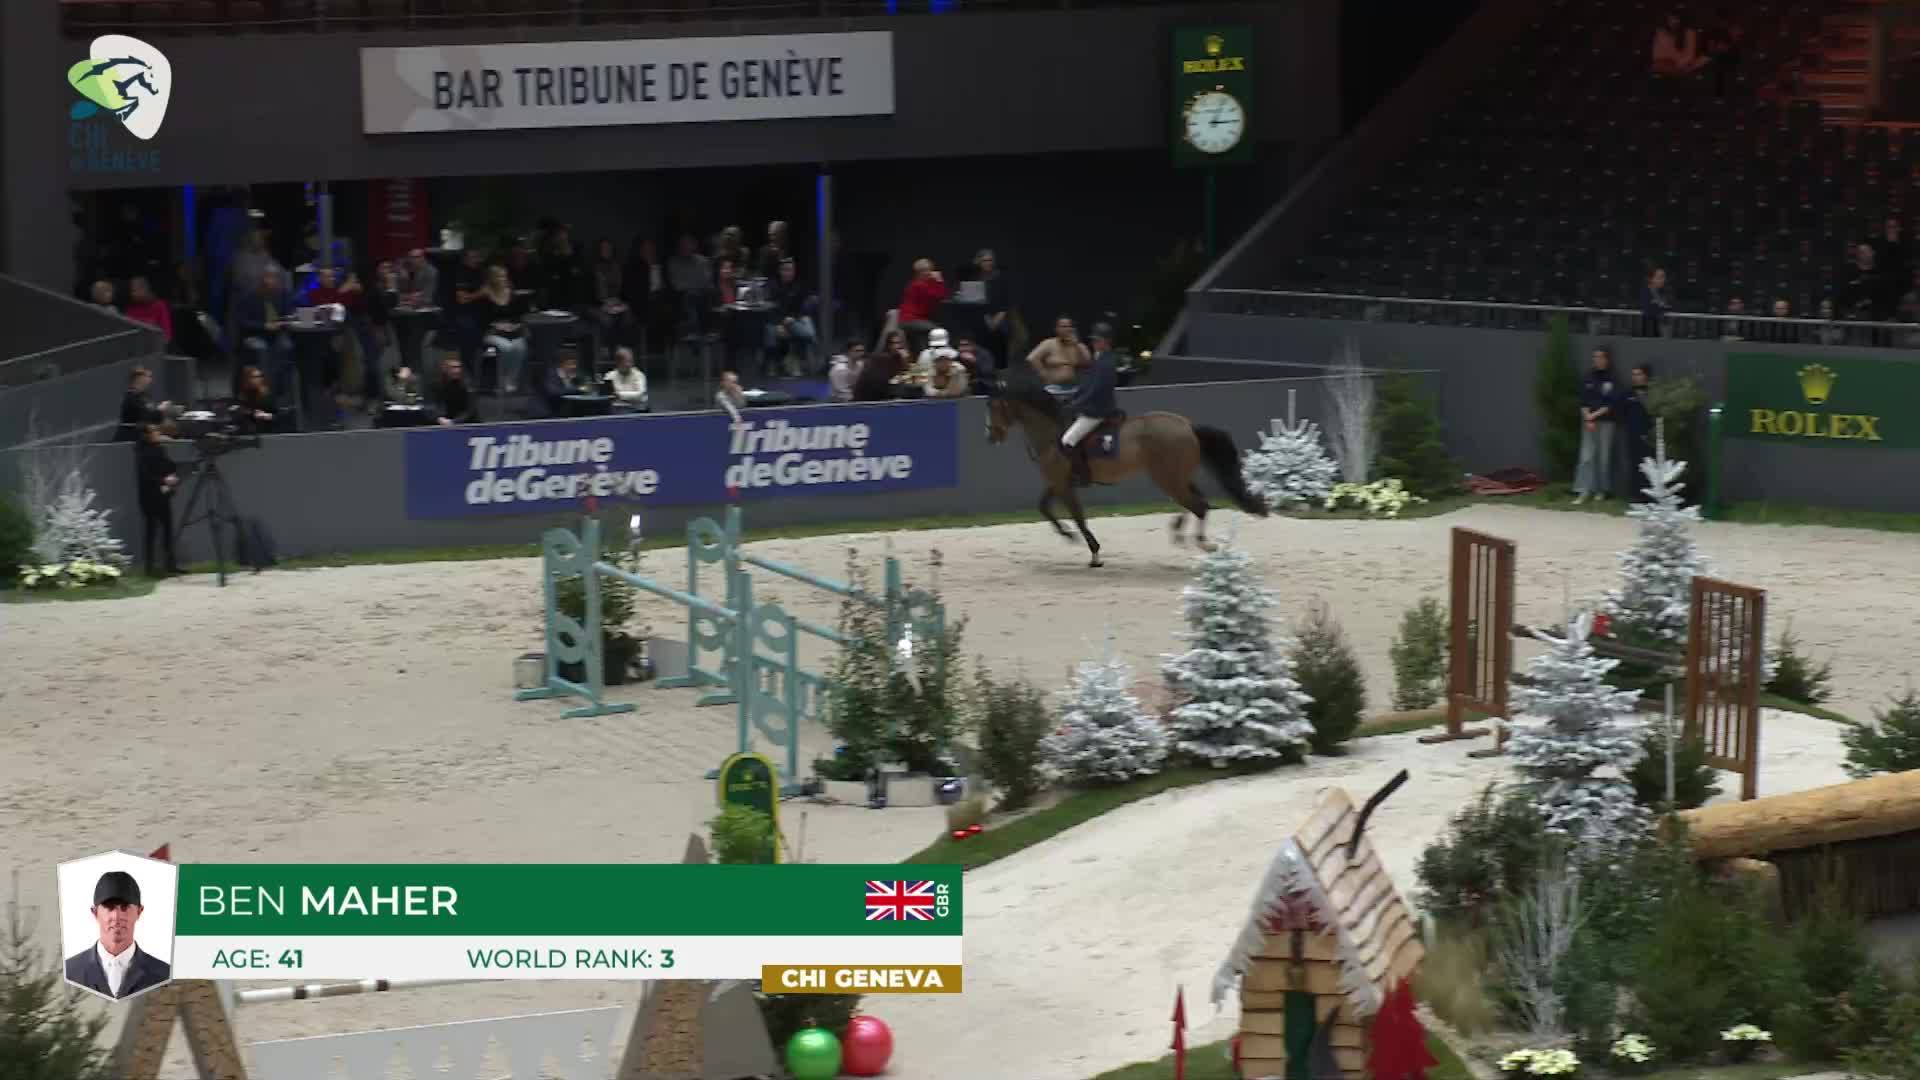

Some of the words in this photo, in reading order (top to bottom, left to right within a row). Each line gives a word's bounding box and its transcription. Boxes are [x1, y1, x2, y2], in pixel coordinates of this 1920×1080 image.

[433, 69, 504, 110] BAR
[512, 63, 657, 107] TRIBUNE
[669, 61, 709, 101] DE
[720, 48, 845, 100] GENÈVE
[728, 418, 870, 454] Tribune
[1749, 408, 1883, 441] ROLEX
[468, 434, 615, 470] Tribune
[725, 449, 913, 488] deGenève
